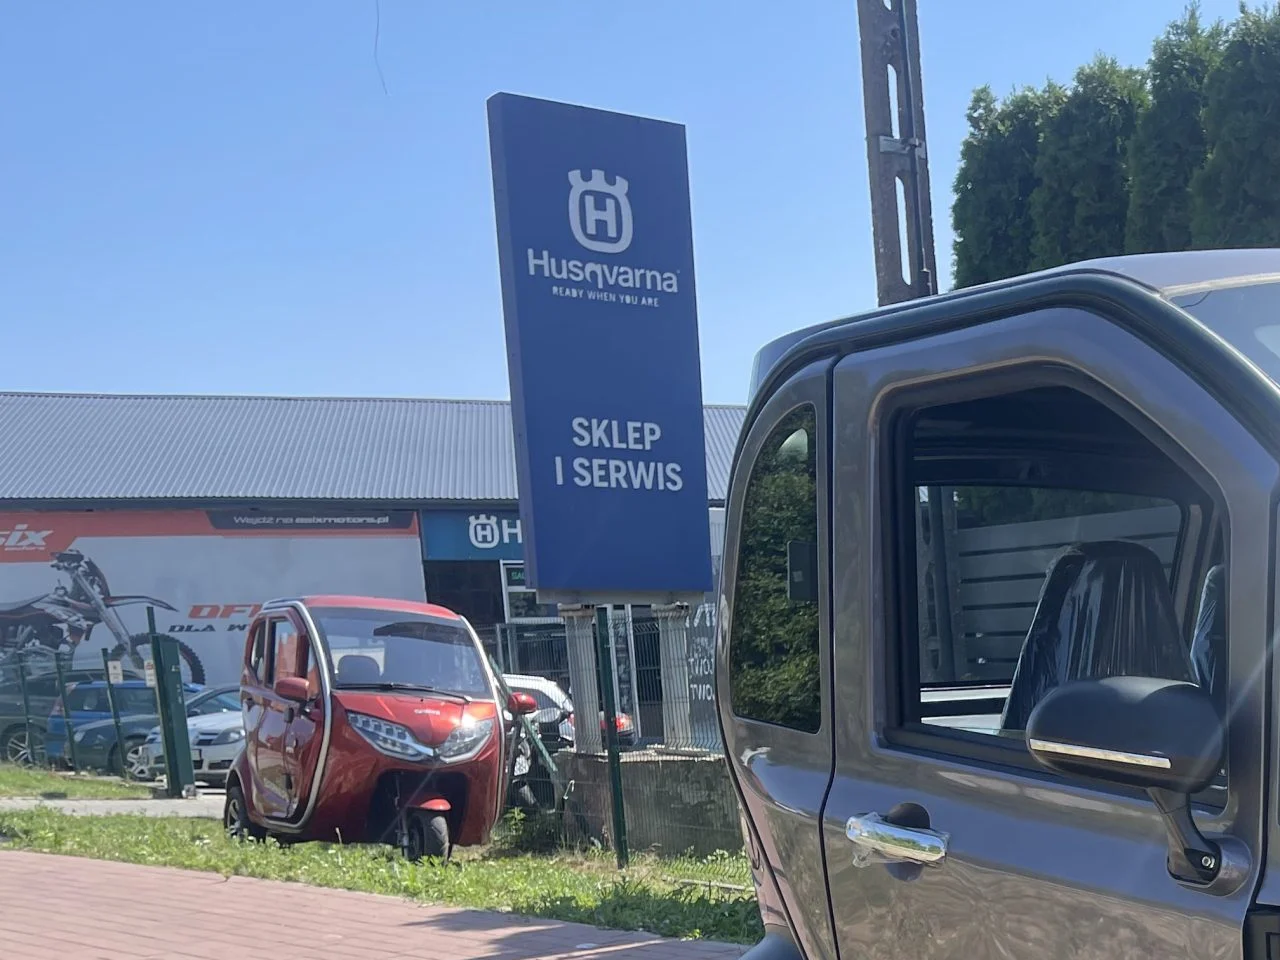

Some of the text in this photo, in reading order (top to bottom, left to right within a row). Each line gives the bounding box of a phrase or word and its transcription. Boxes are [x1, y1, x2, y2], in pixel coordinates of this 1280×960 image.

[527, 248, 679, 293] Husqvarna
[552, 286, 660, 308] READY WHEN YOU ARE
[571, 417, 661, 450] SKLEP
[555, 456, 683, 491] I SERWIS
[501, 519, 523, 544] H
[168, 624, 215, 632] DLA
